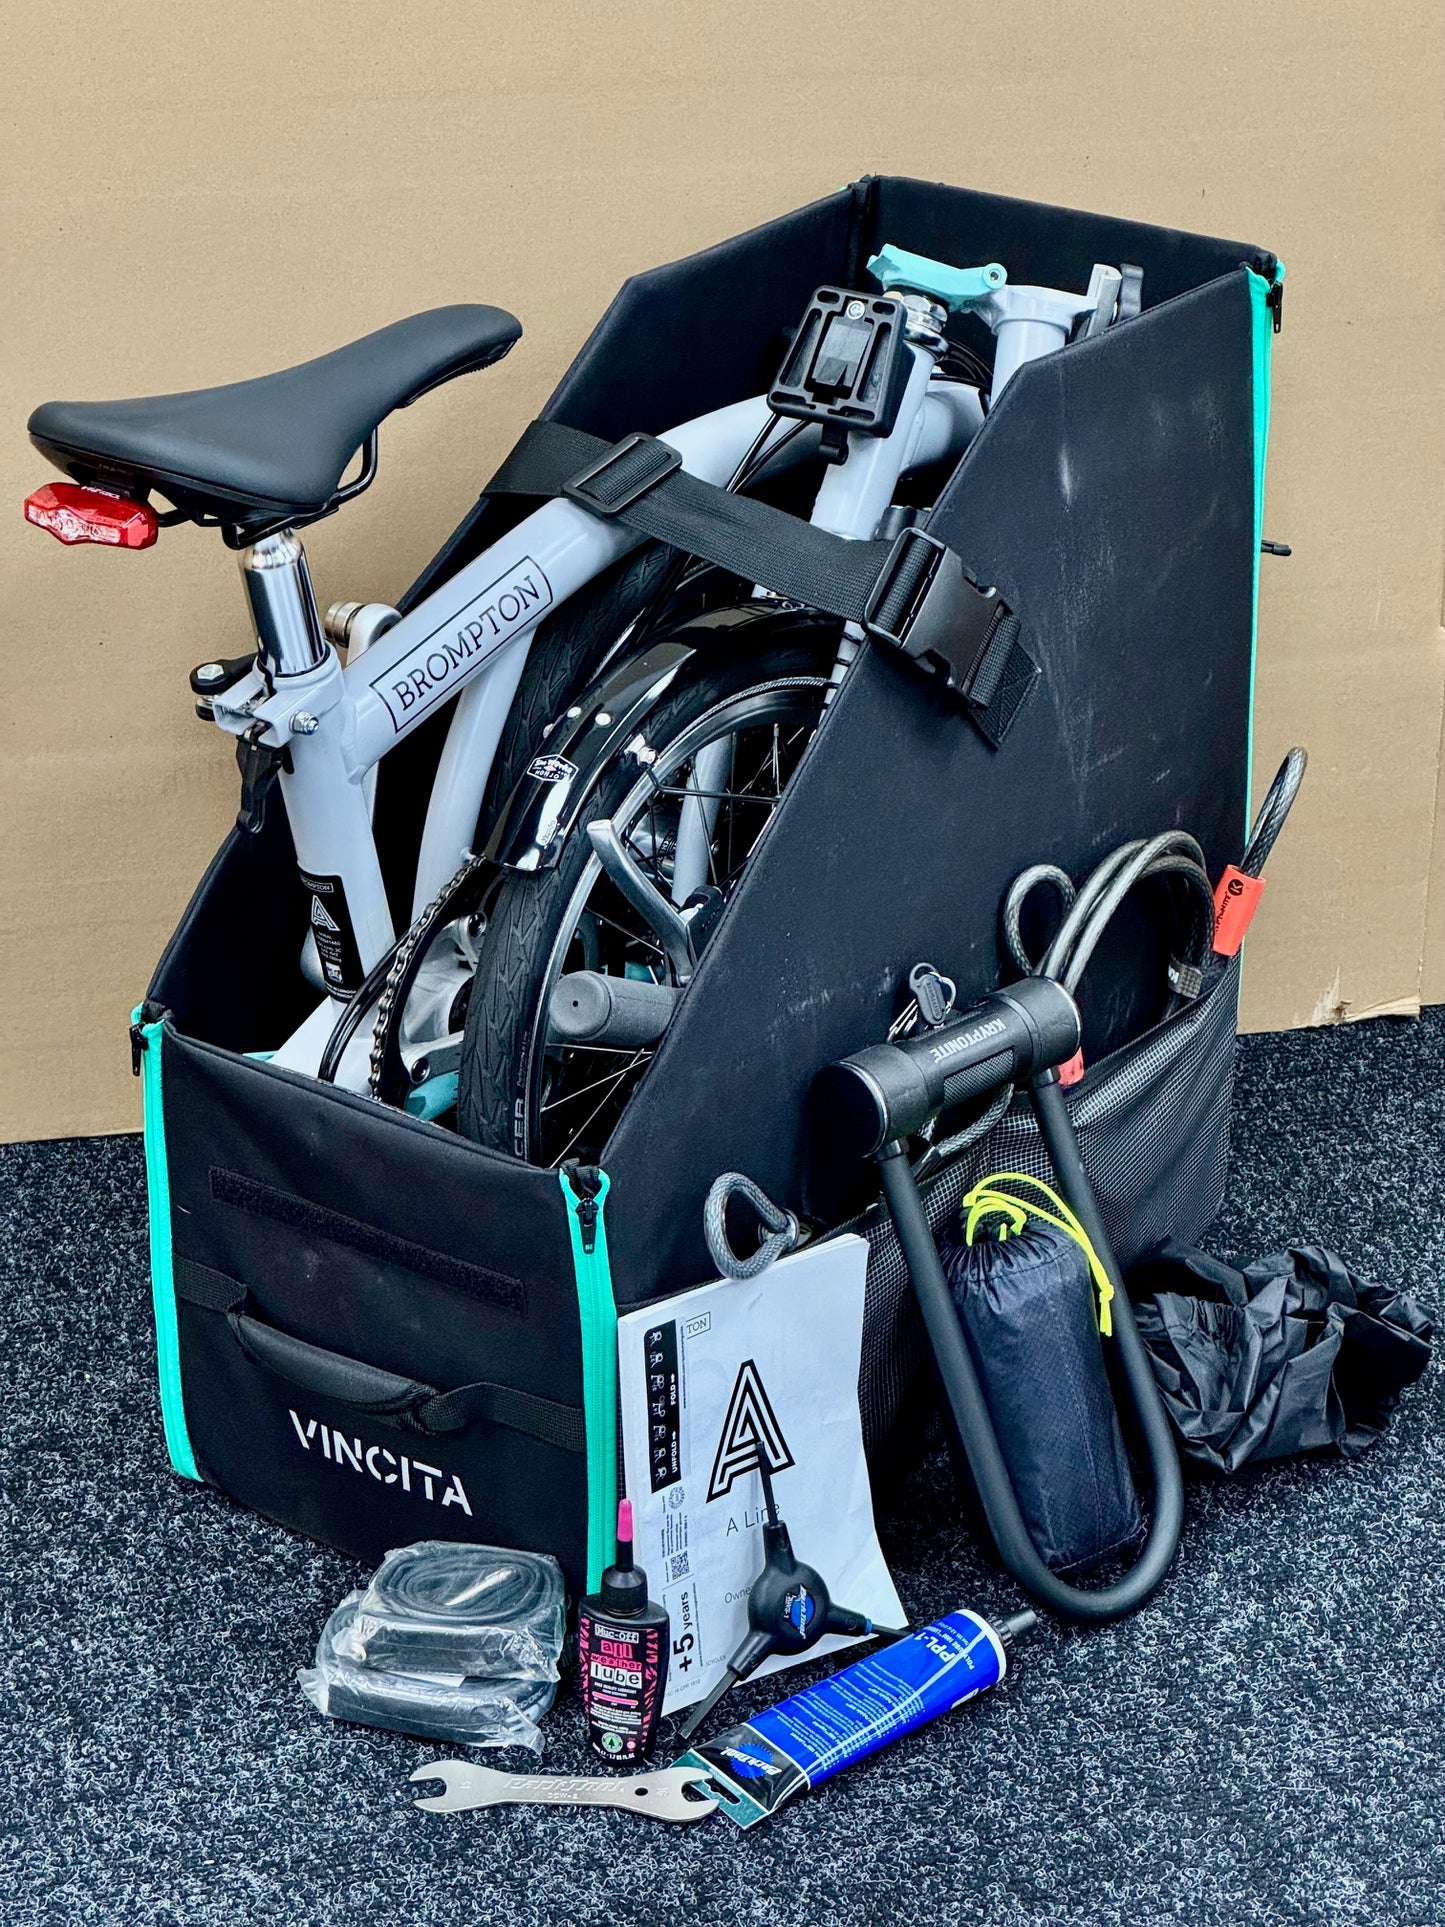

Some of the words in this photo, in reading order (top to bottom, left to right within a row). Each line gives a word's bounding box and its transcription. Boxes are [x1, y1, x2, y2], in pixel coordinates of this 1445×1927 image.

[392, 575, 540, 710] BROMPTON
[929, 1018, 1007, 1063] KRYPTONITE
[289, 1409, 473, 1516] VINCITA
[726, 1517, 739, 1537] A
[725, 1586, 754, 1604] Owne
[681, 1591, 692, 1630] years
[596, 1626, 638, 1642] Muc-Off
[914, 1632, 957, 1662] PPL-1
[602, 1641, 632, 1658] all
[951, 1641, 976, 1670] POLYUBE
[592, 1655, 642, 1671] weather
[594, 1663, 641, 1686] lube
